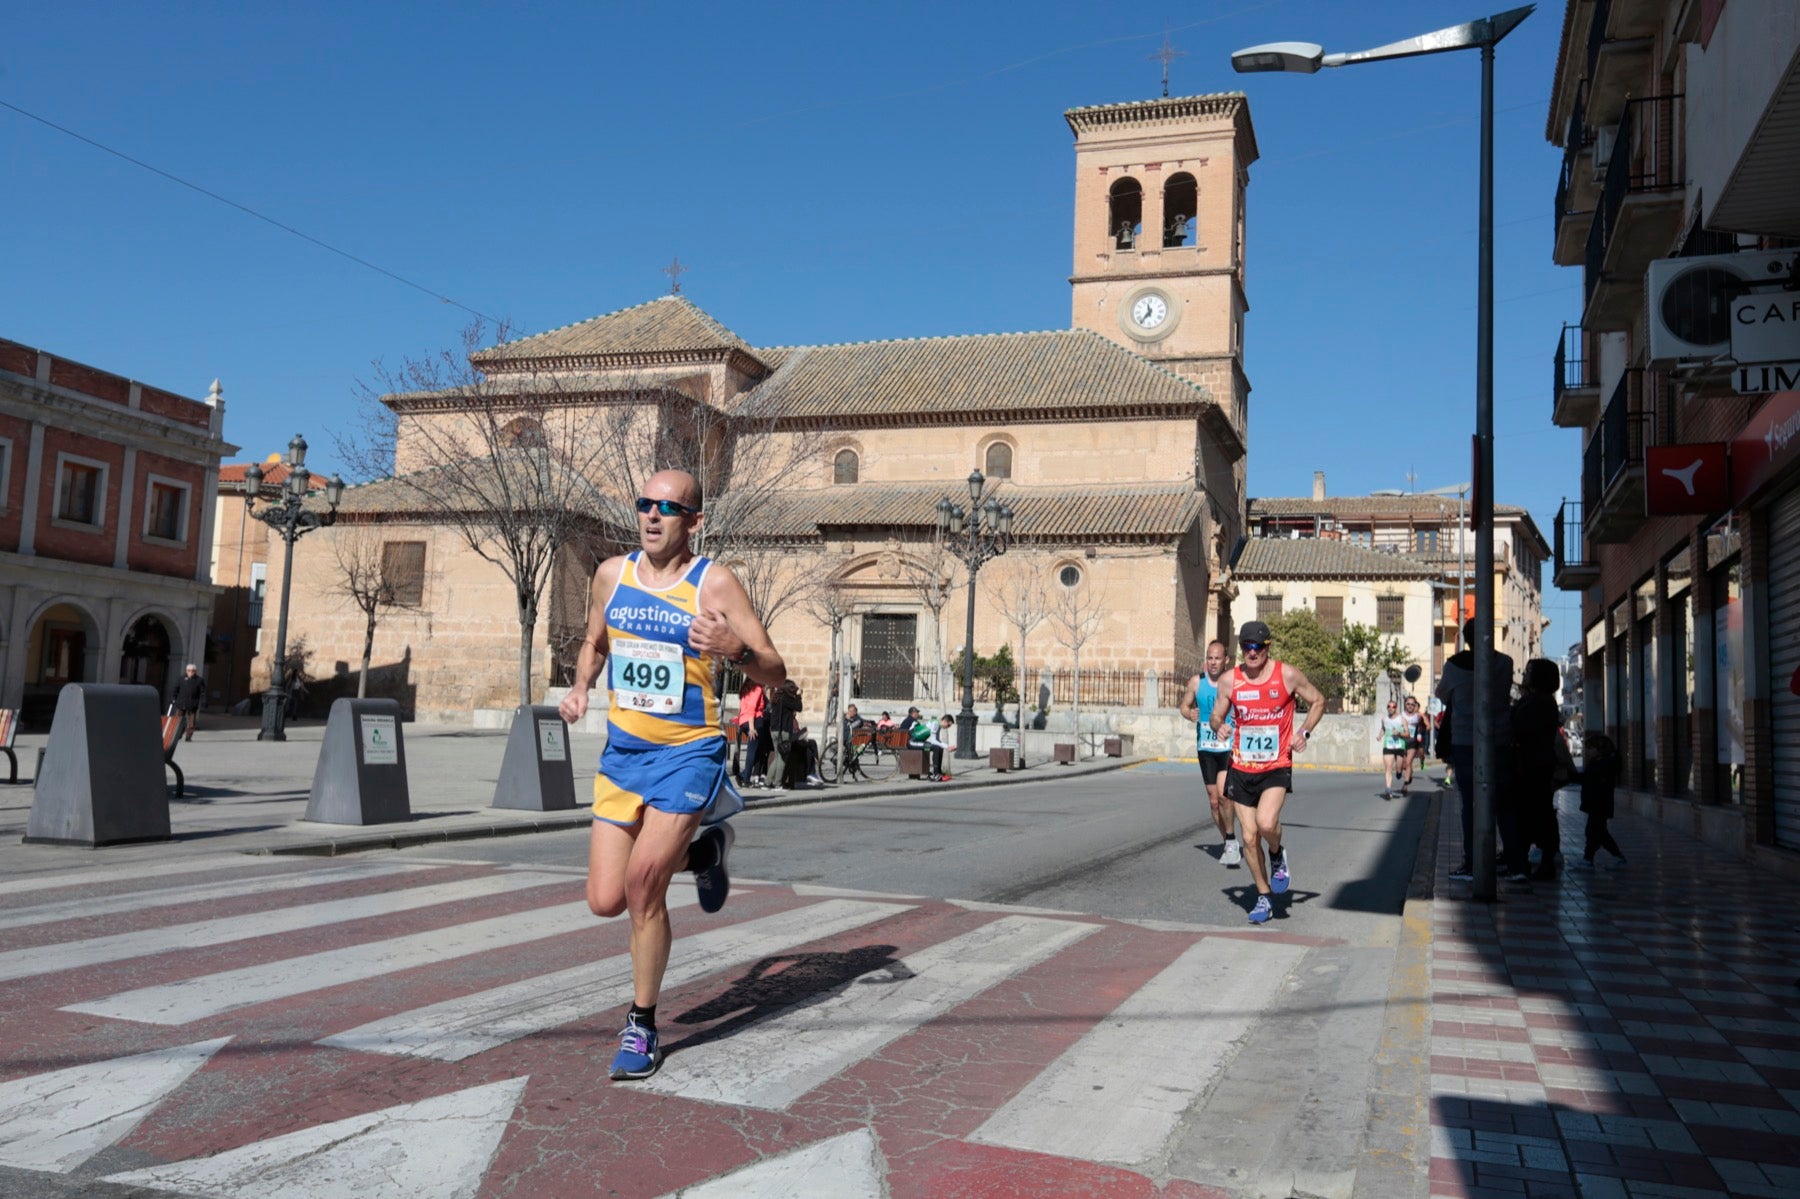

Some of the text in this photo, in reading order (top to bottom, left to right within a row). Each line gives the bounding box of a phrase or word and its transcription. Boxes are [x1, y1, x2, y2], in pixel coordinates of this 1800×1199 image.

[1737, 301, 1800, 324] CAF
[610, 605, 691, 627] agustinos
[618, 622, 676, 635] GRANADA
[622, 661, 671, 690] 499
[1206, 730, 1218, 741] 78
[1246, 736, 1273, 750] 712
